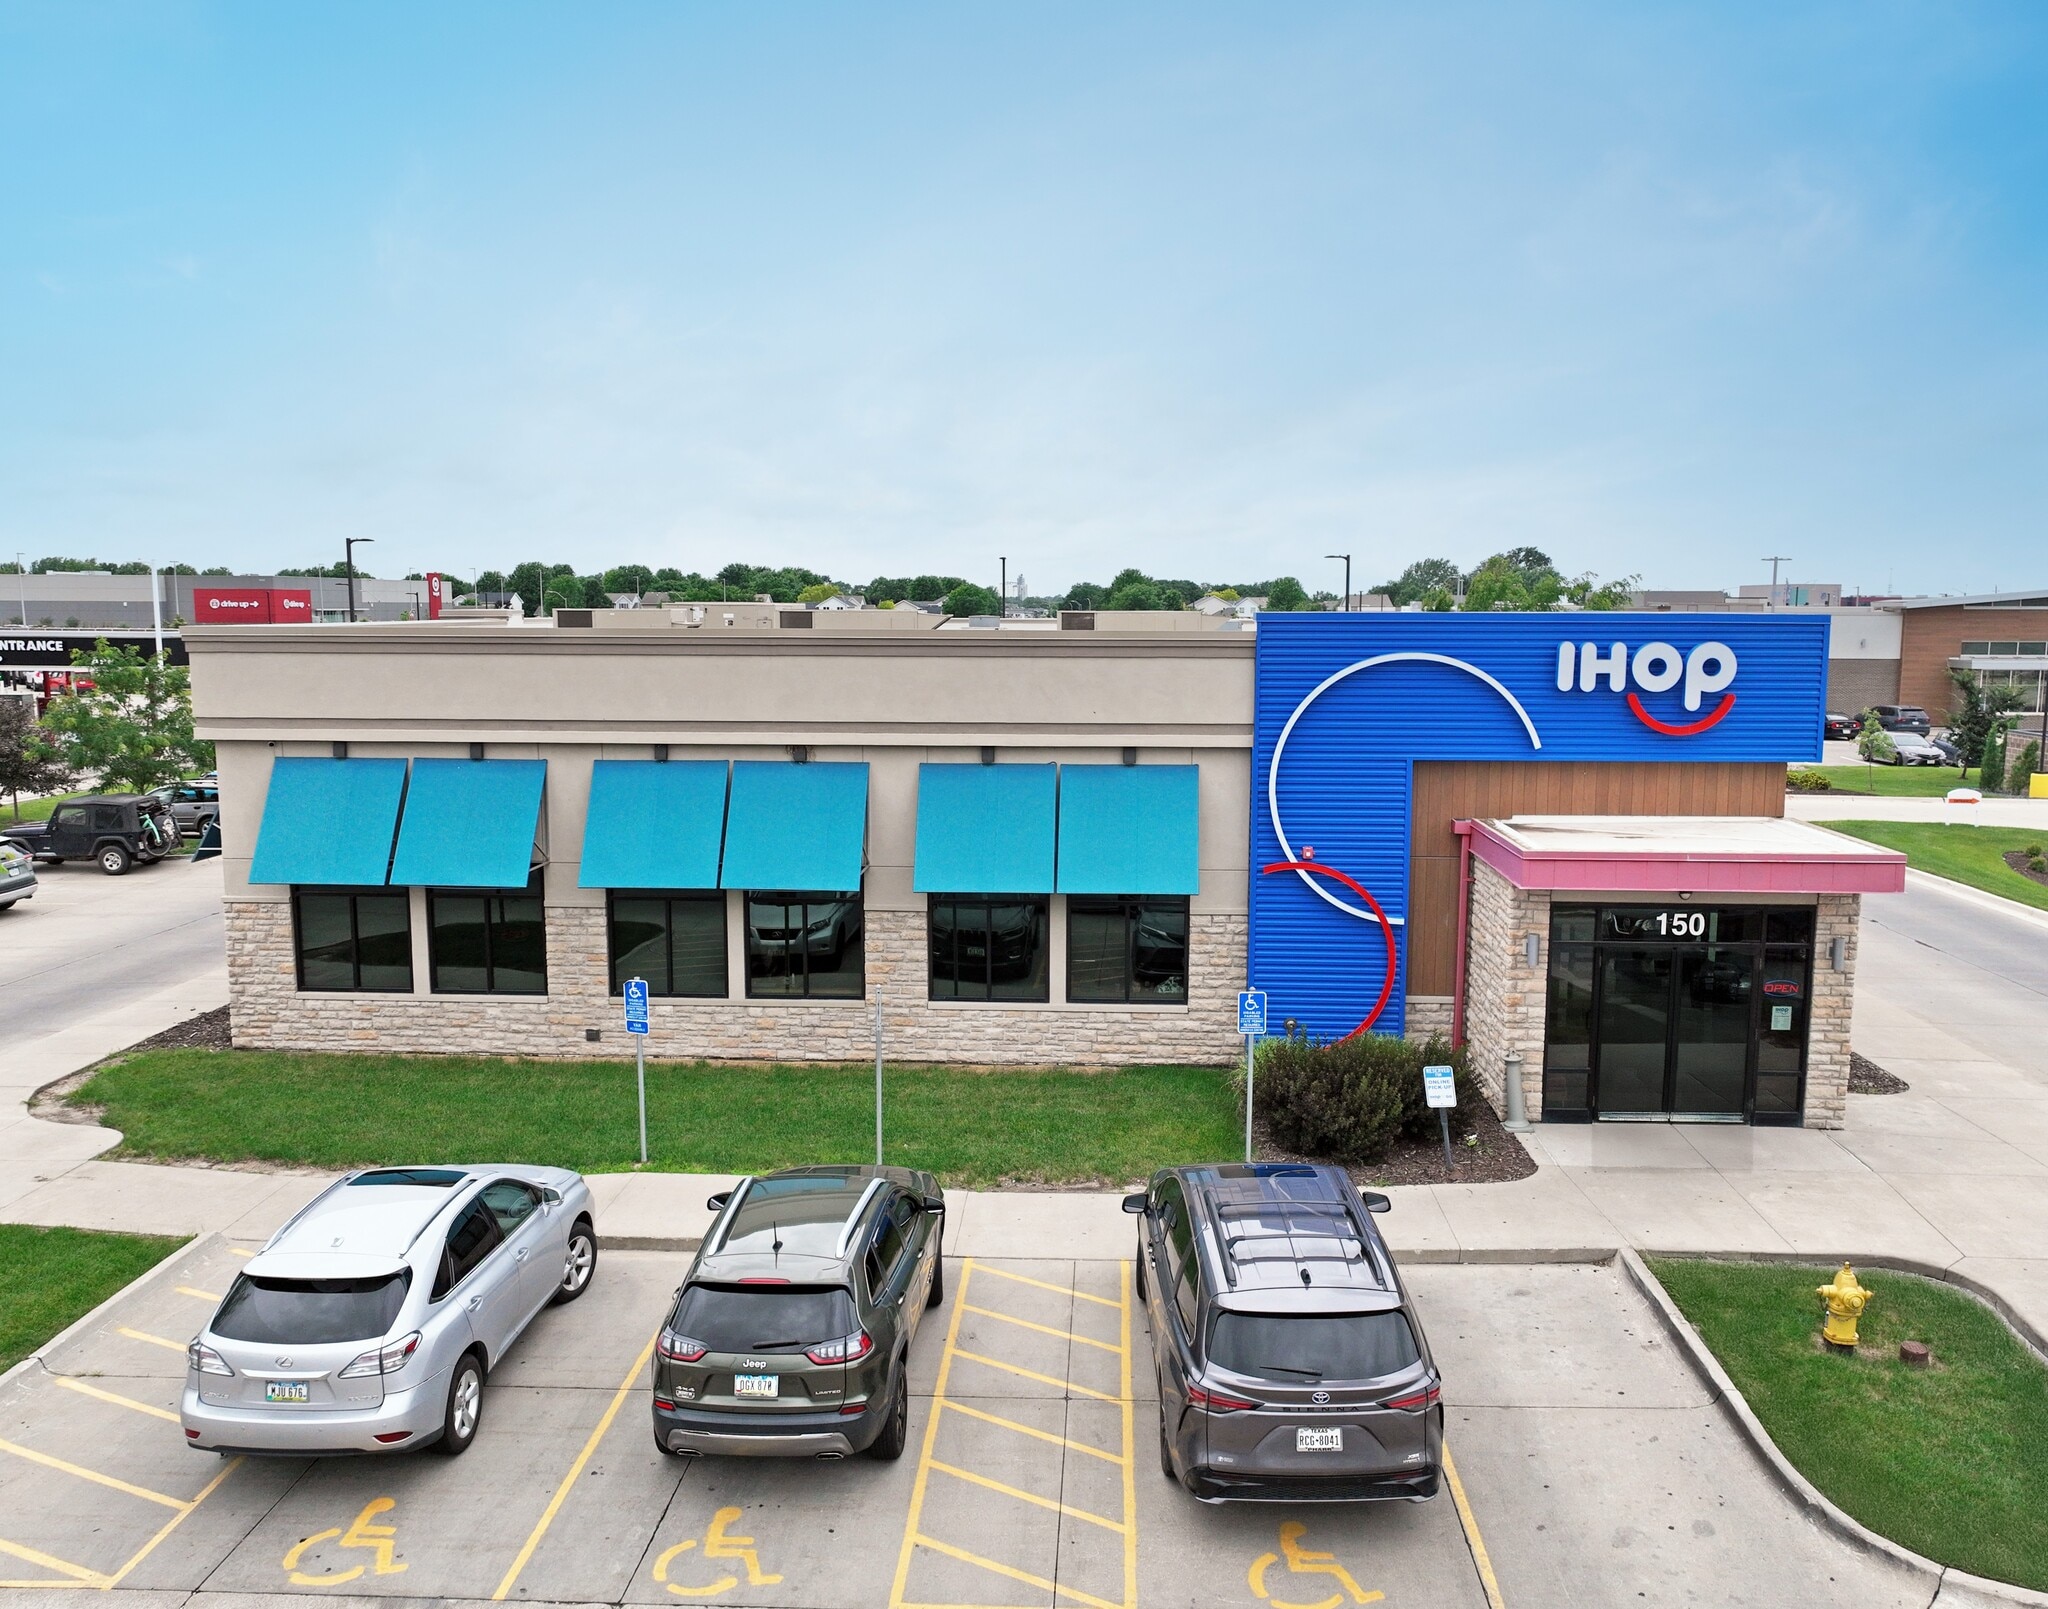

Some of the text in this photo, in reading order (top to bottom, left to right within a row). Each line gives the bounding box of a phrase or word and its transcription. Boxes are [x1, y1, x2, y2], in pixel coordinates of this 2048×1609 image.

[1556, 640, 1738, 712] IHOP
[1656, 912, 1706, 936] 150
[1764, 983, 1799, 993] OPEN
[742, 1358, 767, 1370] Jeep
[757, 1380, 772, 1391] 870
[288, 1387, 303, 1398] 676
